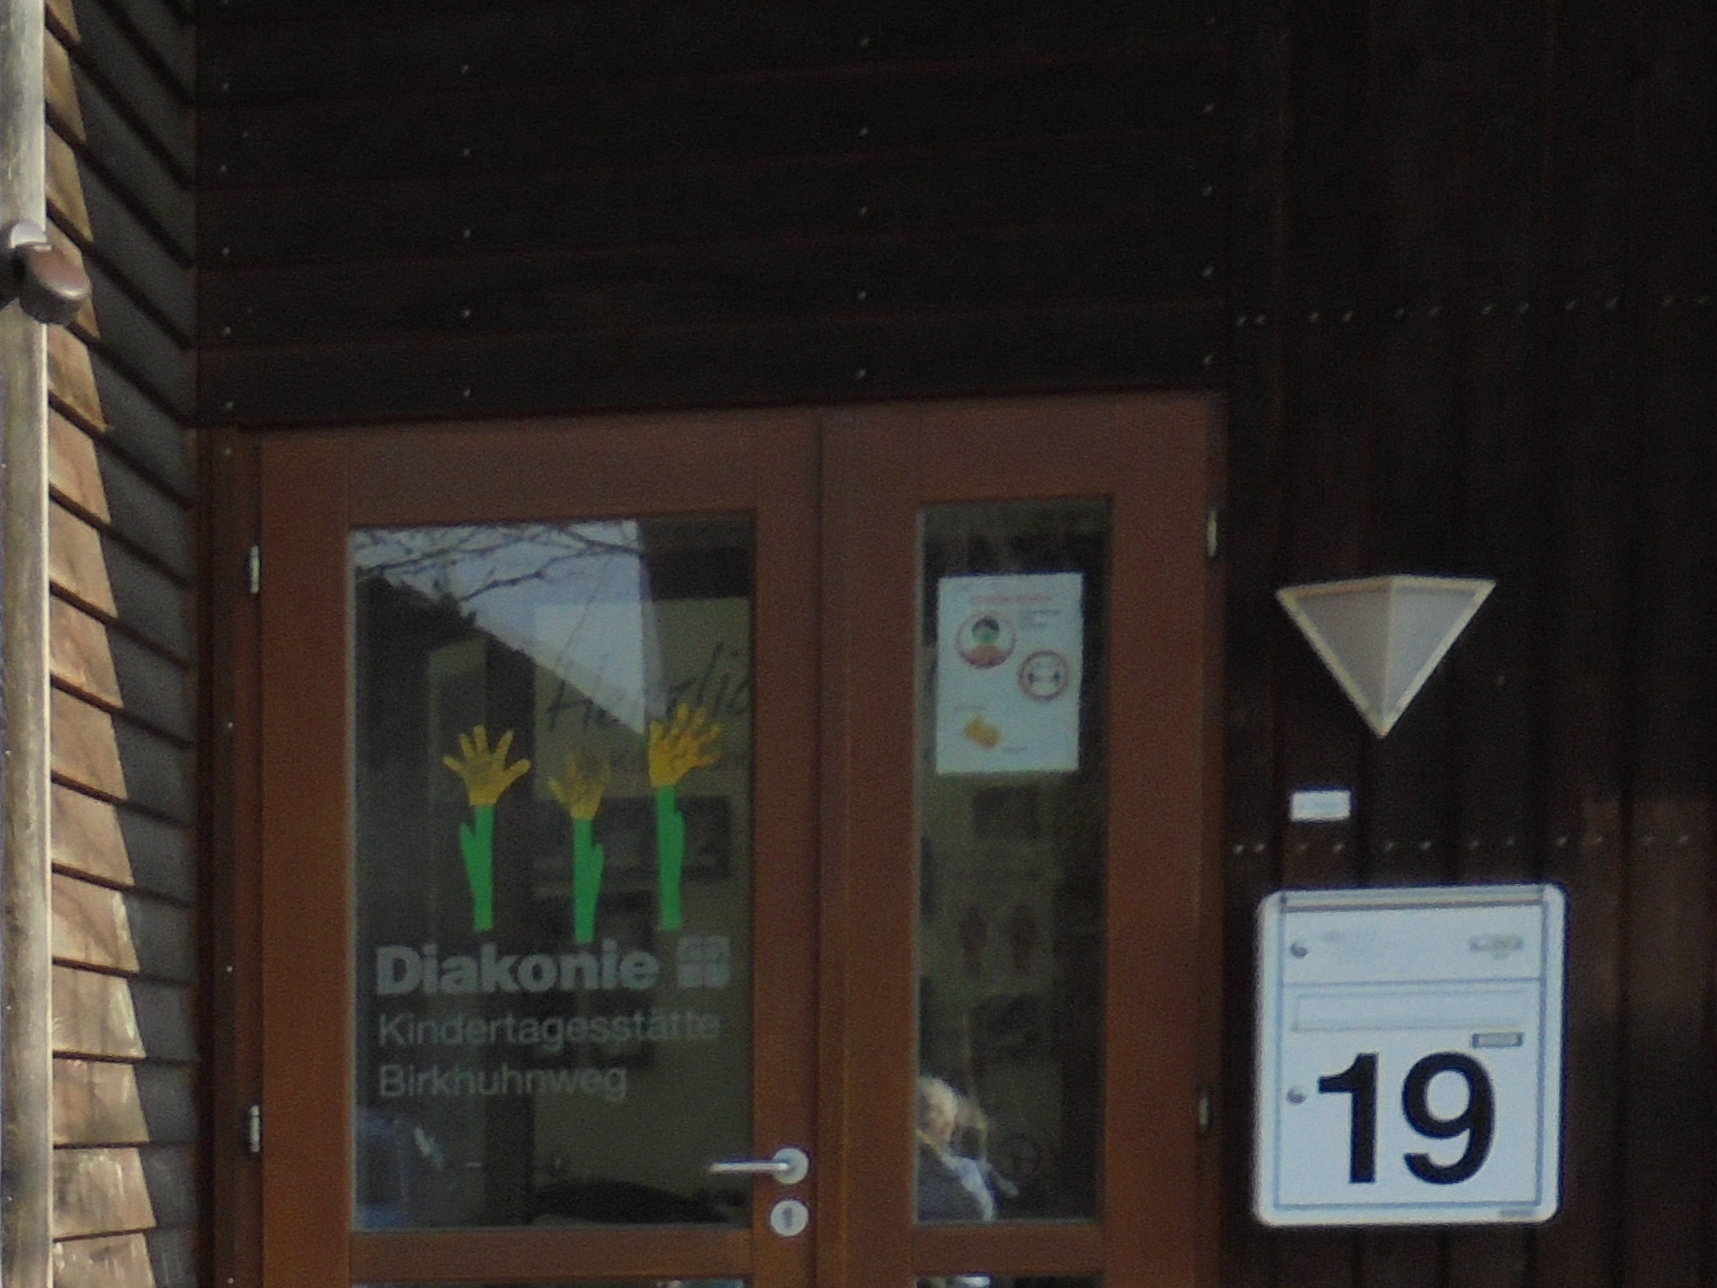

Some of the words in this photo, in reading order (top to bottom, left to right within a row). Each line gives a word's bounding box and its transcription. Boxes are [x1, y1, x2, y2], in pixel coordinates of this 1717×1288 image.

[376, 938, 661, 995] Diakonie
[379, 1009, 722, 1053] Kindertagesstätte
[379, 1062, 628, 1099] Birkhuhnweg
[1317, 1050, 1496, 1186] 19
